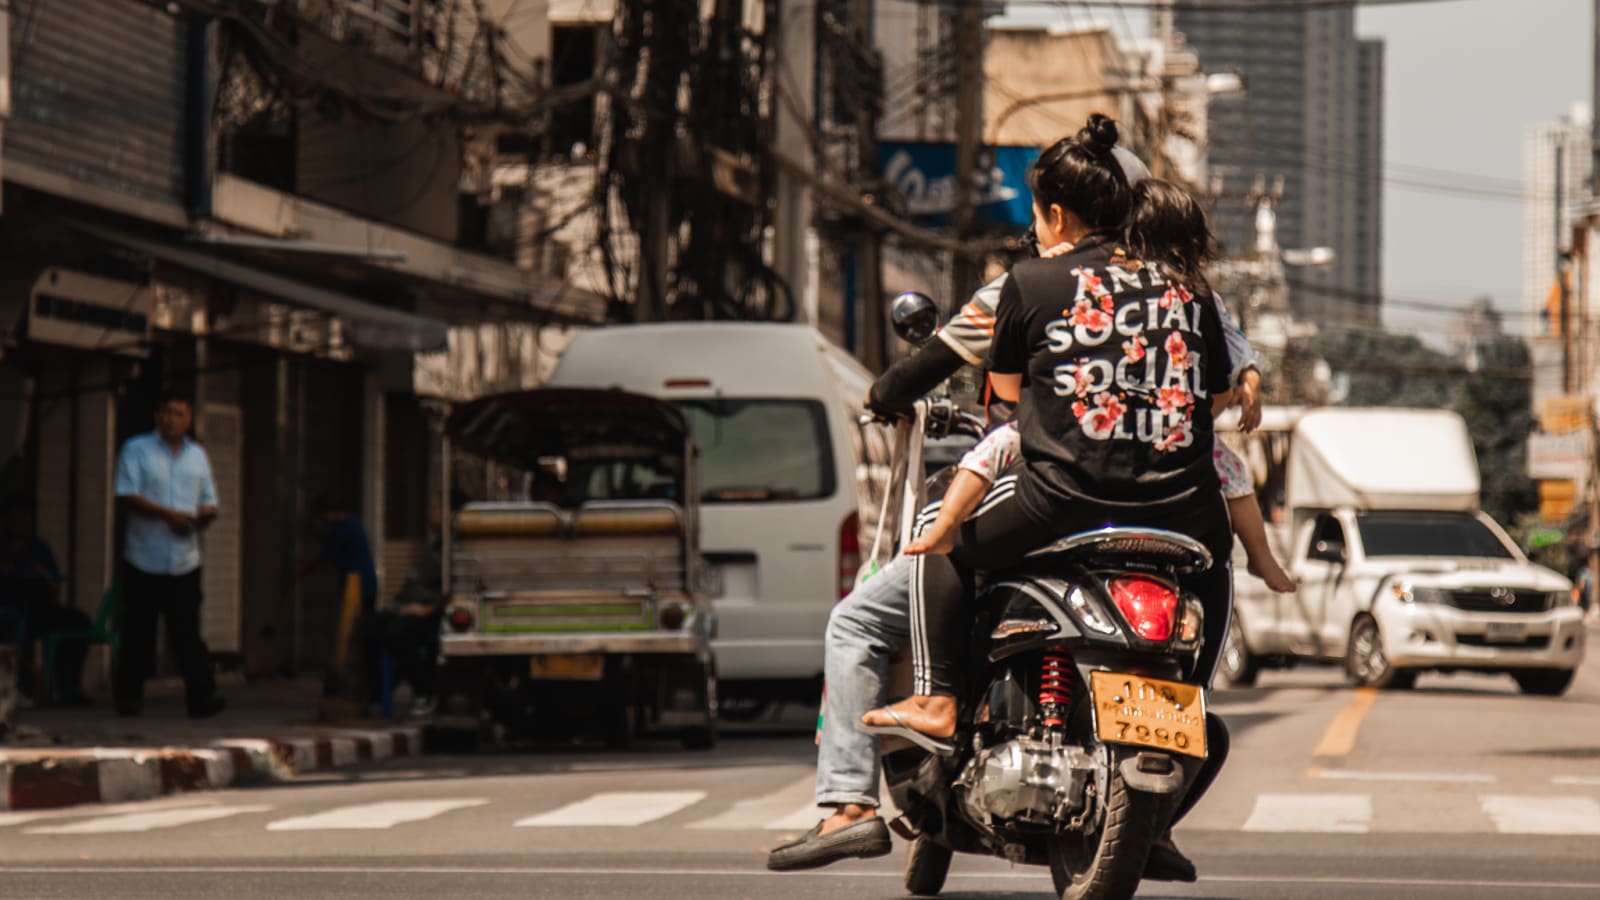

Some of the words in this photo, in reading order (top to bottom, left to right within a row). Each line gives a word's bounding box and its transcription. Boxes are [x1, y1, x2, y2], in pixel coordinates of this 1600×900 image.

[1044, 297, 1203, 353] SOCIAL
[1053, 346, 1207, 399] SOCIAL
[1081, 408, 1194, 447] CLUB
